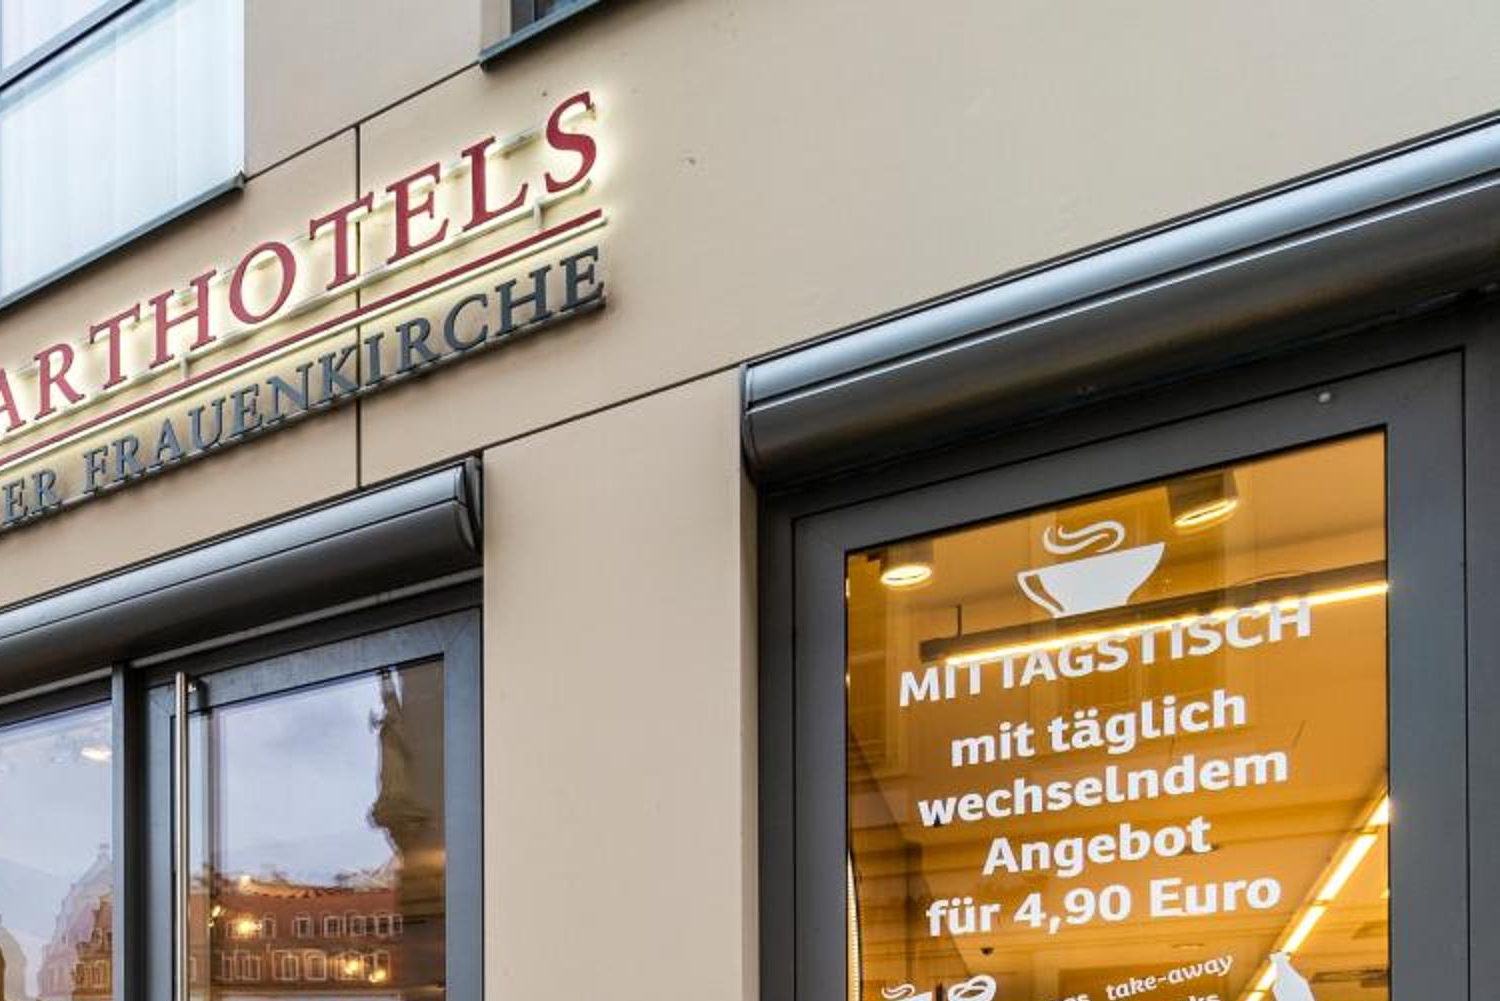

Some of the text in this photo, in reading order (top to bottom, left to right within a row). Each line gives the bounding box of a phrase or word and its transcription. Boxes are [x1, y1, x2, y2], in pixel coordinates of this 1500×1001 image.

[82, 245, 607, 498] FRAUENKIRCHE
[899, 598, 1312, 708] MITTAGSTISCH
[951, 689, 1247, 767] mit täglich
[918, 749, 1289, 827] wechselndem
[982, 816, 1212, 878] Angebot
[925, 875, 1281, 937] für 4,90 Euro
[1106, 954, 1235, 1001] take-away
